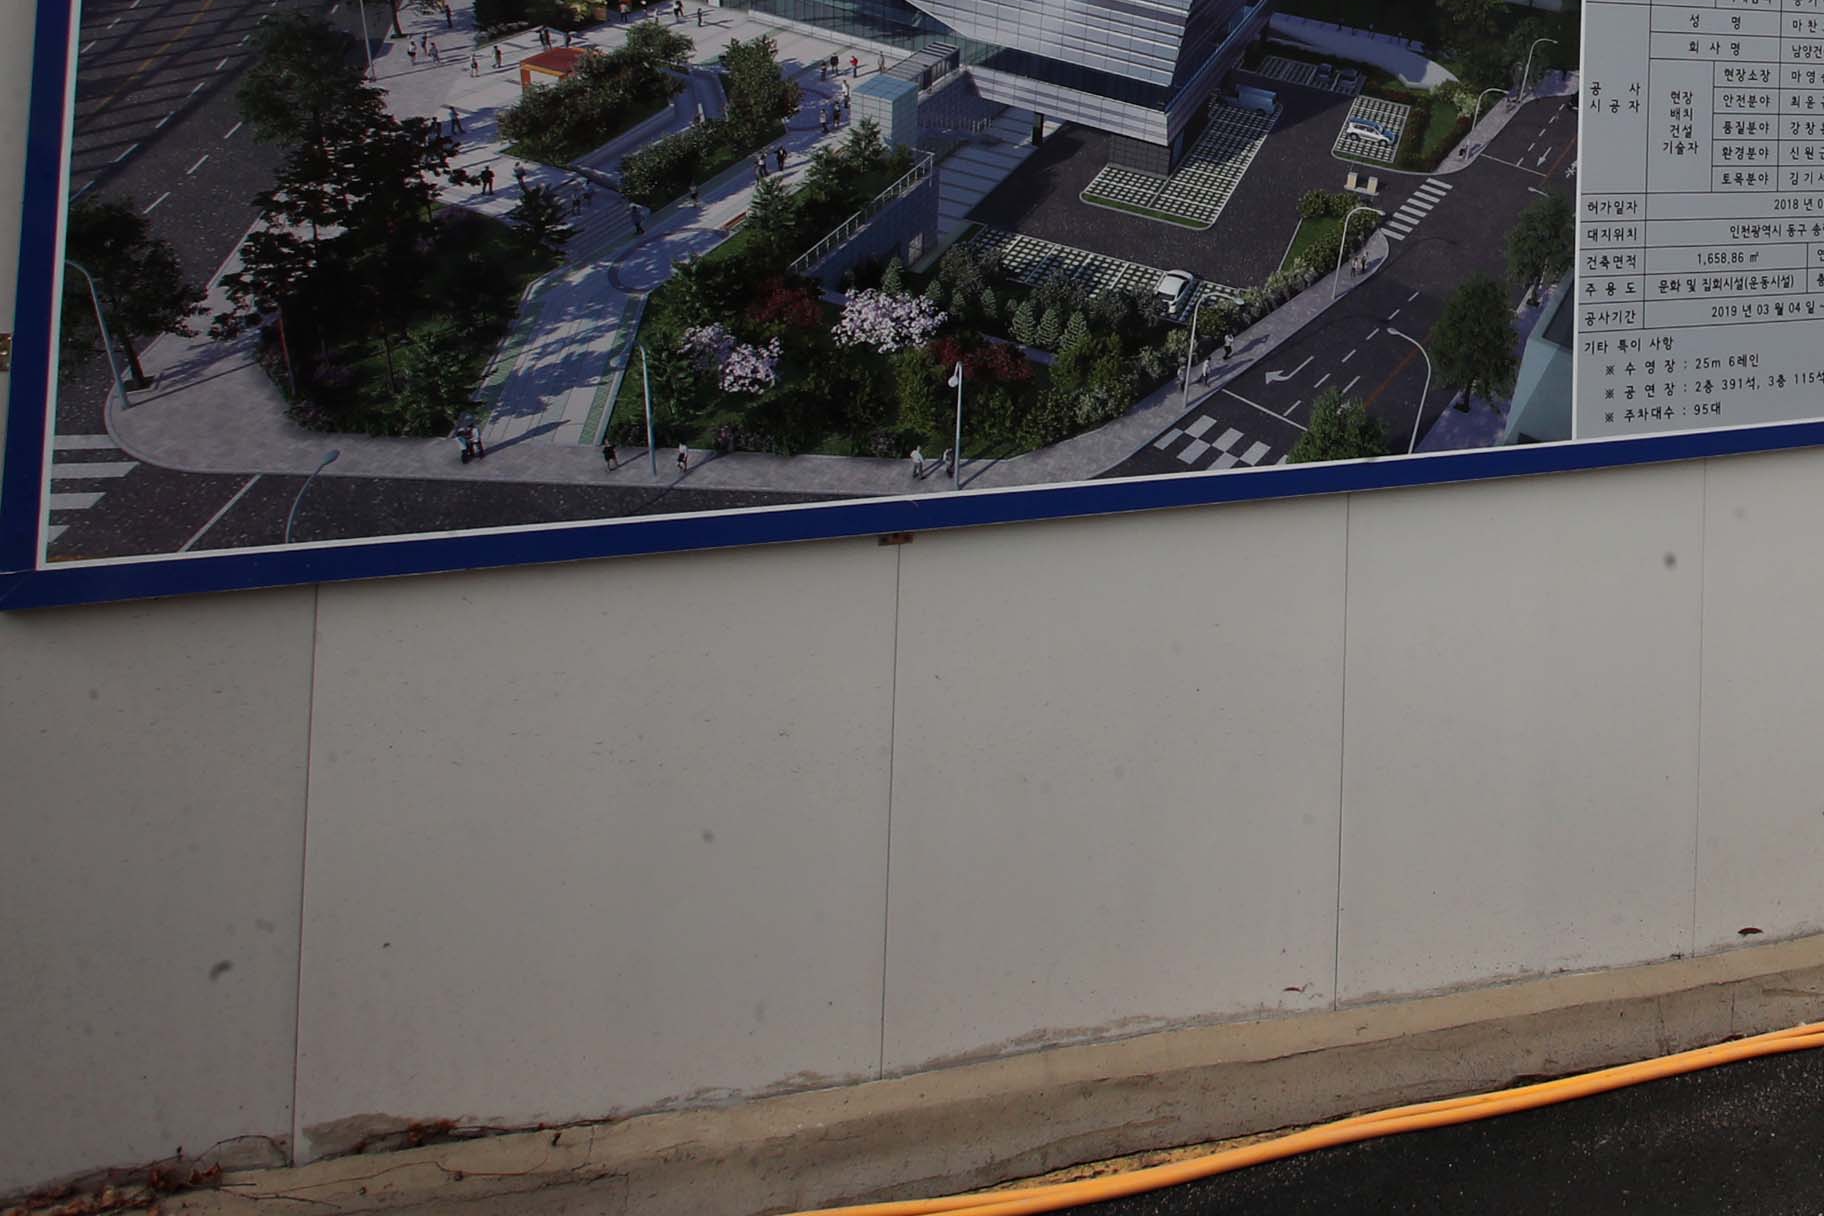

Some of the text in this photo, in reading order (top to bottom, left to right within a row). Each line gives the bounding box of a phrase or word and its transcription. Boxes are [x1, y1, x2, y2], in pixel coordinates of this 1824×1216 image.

[1724, 69, 1770, 82] 현장소장
[1723, 94, 1770, 108] 안전분야
[1722, 146, 1769, 161] 환경분야
[1722, 172, 1768, 186] 토목분야
[1588, 200, 1637, 215] 허가일자
[1774, 199, 1799, 210] 2018
[1804, 199, 1813, 211] 년
[1587, 227, 1637, 242] 대지위치
[1730, 224, 1782, 239] 인천광역시
[1787, 224, 1807, 237] 동구
[1586, 255, 1636, 270] 건축면적
[1712, 306, 1737, 318] 2019
[1742, 304, 1752, 318] 년
[1757, 304, 1769, 315] 03
[1788, 302, 1801, 313] 04
[1806, 300, 1815, 314] 일
[1585, 310, 1636, 326] 공사기간
[1585, 340, 1608, 355] 기타
[1650, 337, 1673, 351] 사항
[1694, 402, 1721, 416] 95대
